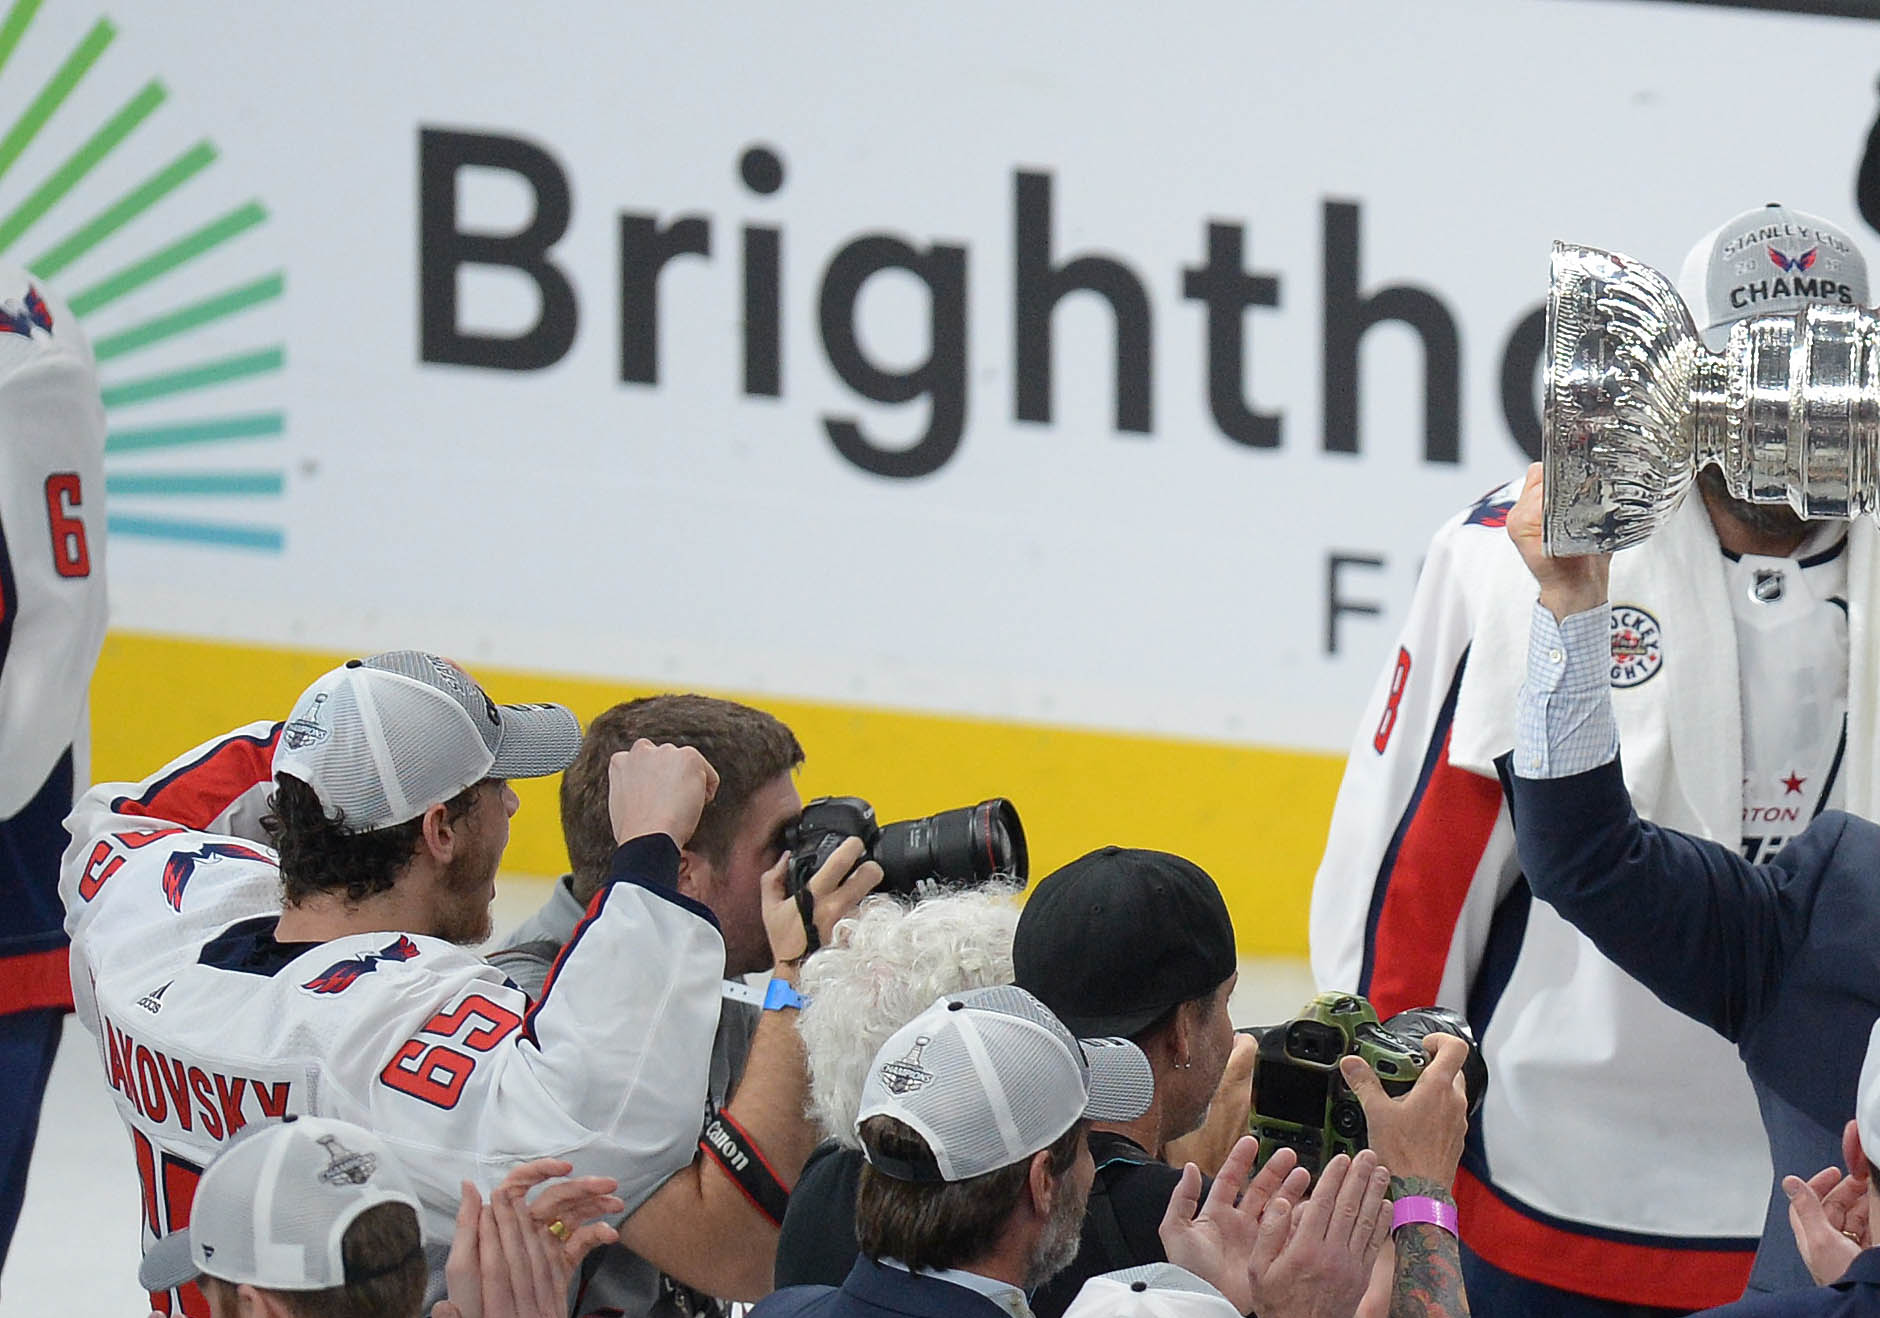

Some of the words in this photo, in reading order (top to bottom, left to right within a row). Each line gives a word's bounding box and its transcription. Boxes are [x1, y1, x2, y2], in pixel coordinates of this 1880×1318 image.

[1728, 275, 1853, 309] CHAMPS
[45, 472, 90, 578] 6
[1373, 645, 1412, 756] 8
[380, 994, 522, 1110] 65
[706, 1120, 750, 1172] Canon
